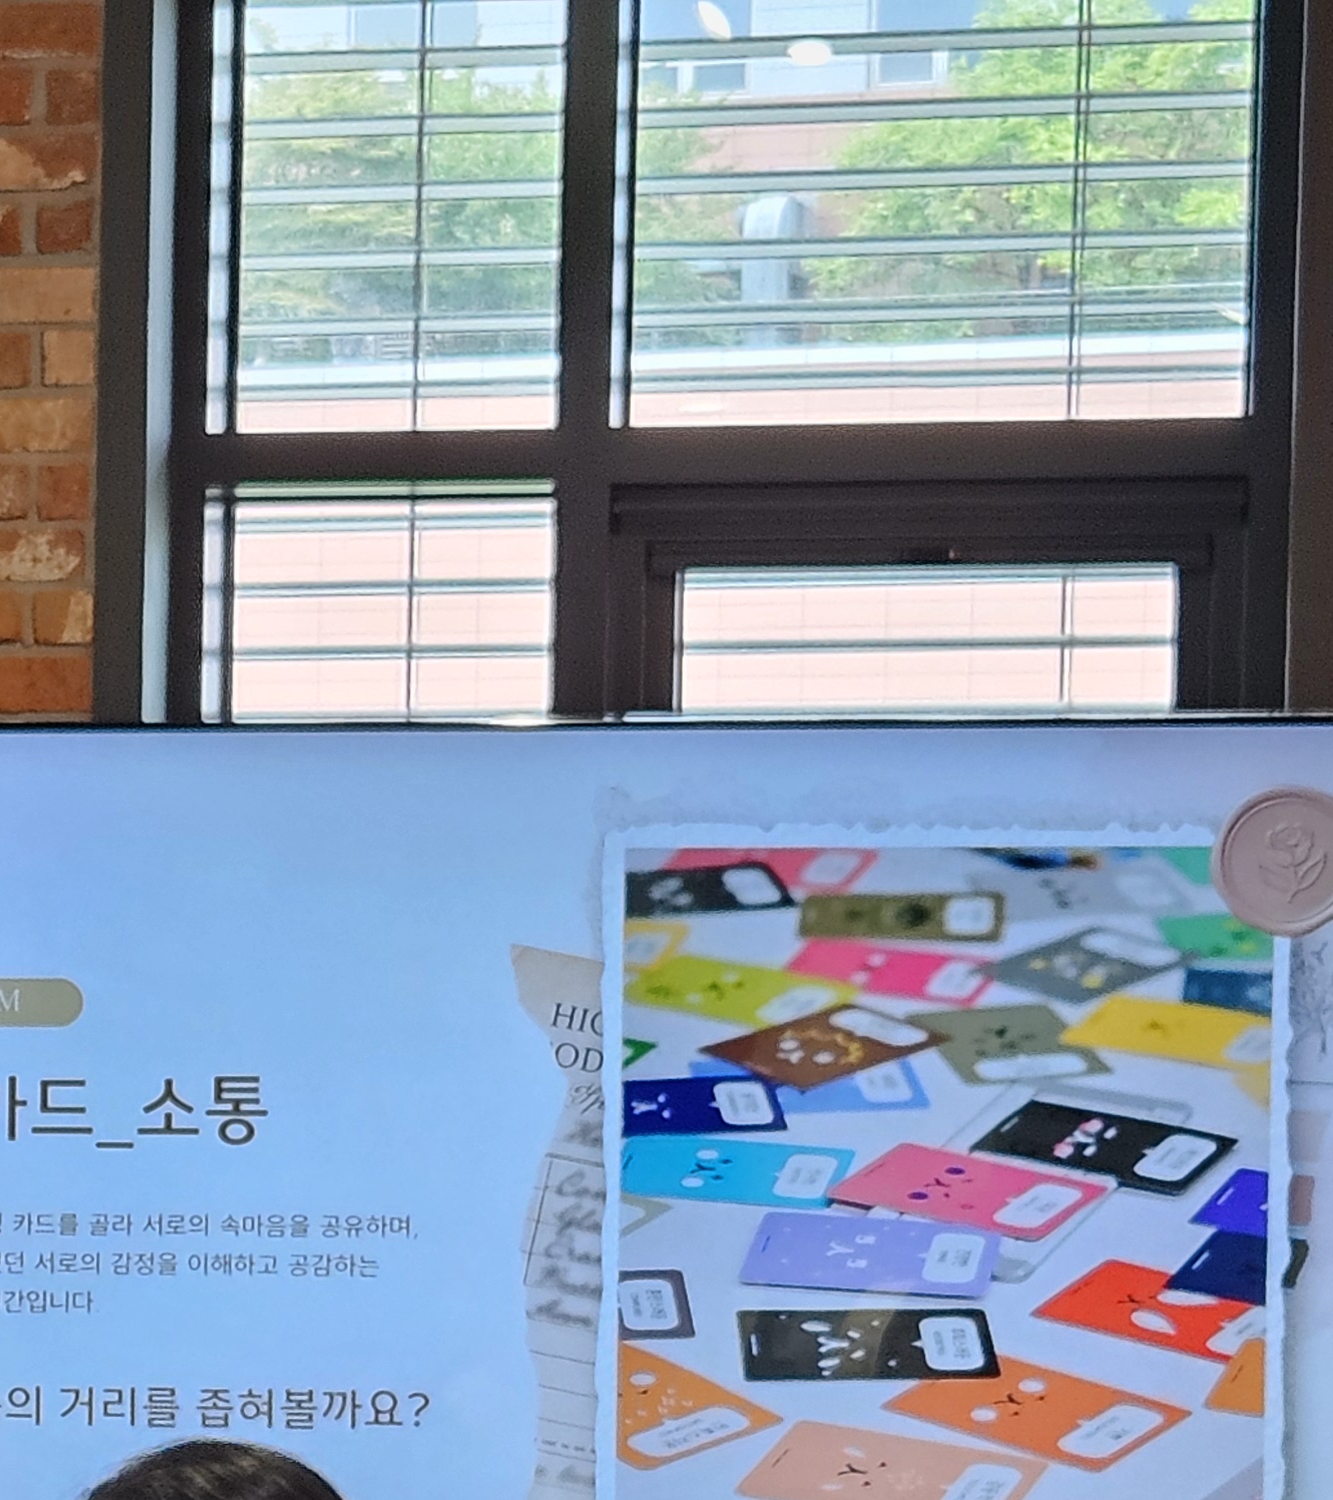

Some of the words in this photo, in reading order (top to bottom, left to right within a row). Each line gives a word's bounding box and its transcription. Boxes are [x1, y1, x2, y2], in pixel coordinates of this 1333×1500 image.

[550, 1041, 604, 1073] OD
[14, 1213, 78, 1236] 카드를
[90, 1214, 132, 1236] 골라
[143, 1214, 208, 1236] 서로의
[221, 1215, 309, 1237] 속마음을
[322, 1215, 417, 1238] 공유하며,
[35, 1252, 100, 1275] 서로의
[112, 1252, 177, 1275] 감정을
[188, 1253, 277, 1276] 이해하고
[289, 1254, 379, 1277] 공감하는
[60, 1387, 179, 1428] 거리를
[196, 1389, 429, 1429] 좁혀볼까요?
